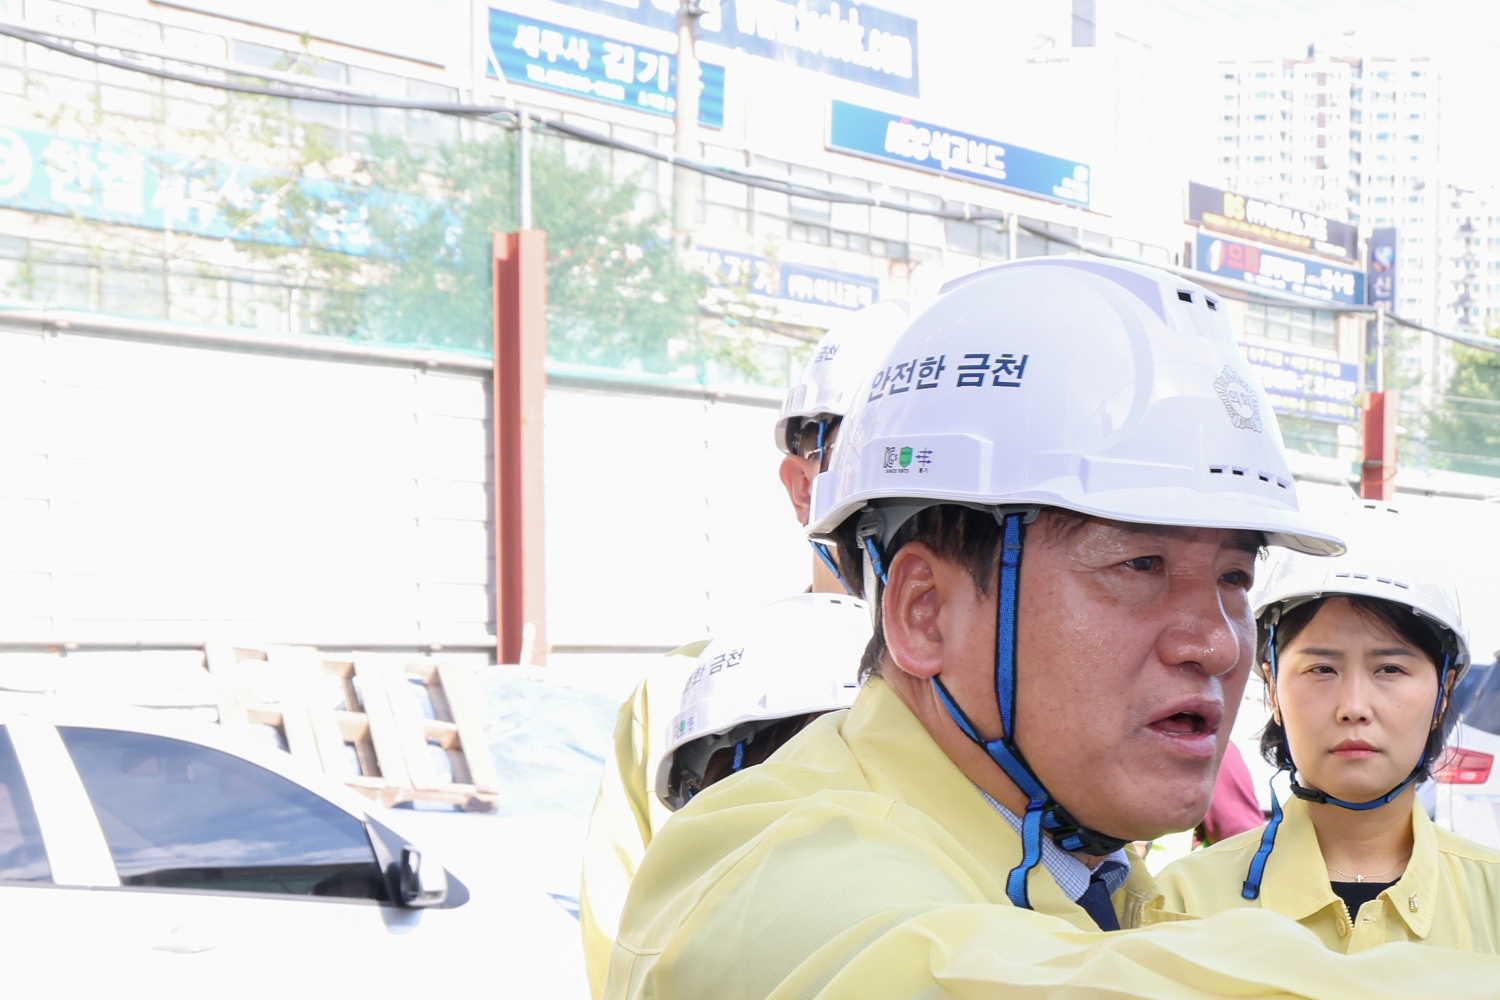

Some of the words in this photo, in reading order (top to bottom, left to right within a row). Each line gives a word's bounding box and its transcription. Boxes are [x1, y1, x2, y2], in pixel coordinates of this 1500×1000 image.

[513, 24, 590, 70] 세무사
[868, 354, 945, 402] 안전한
[956, 353, 1029, 388] 금천
[709, 647, 745, 676] 금천
